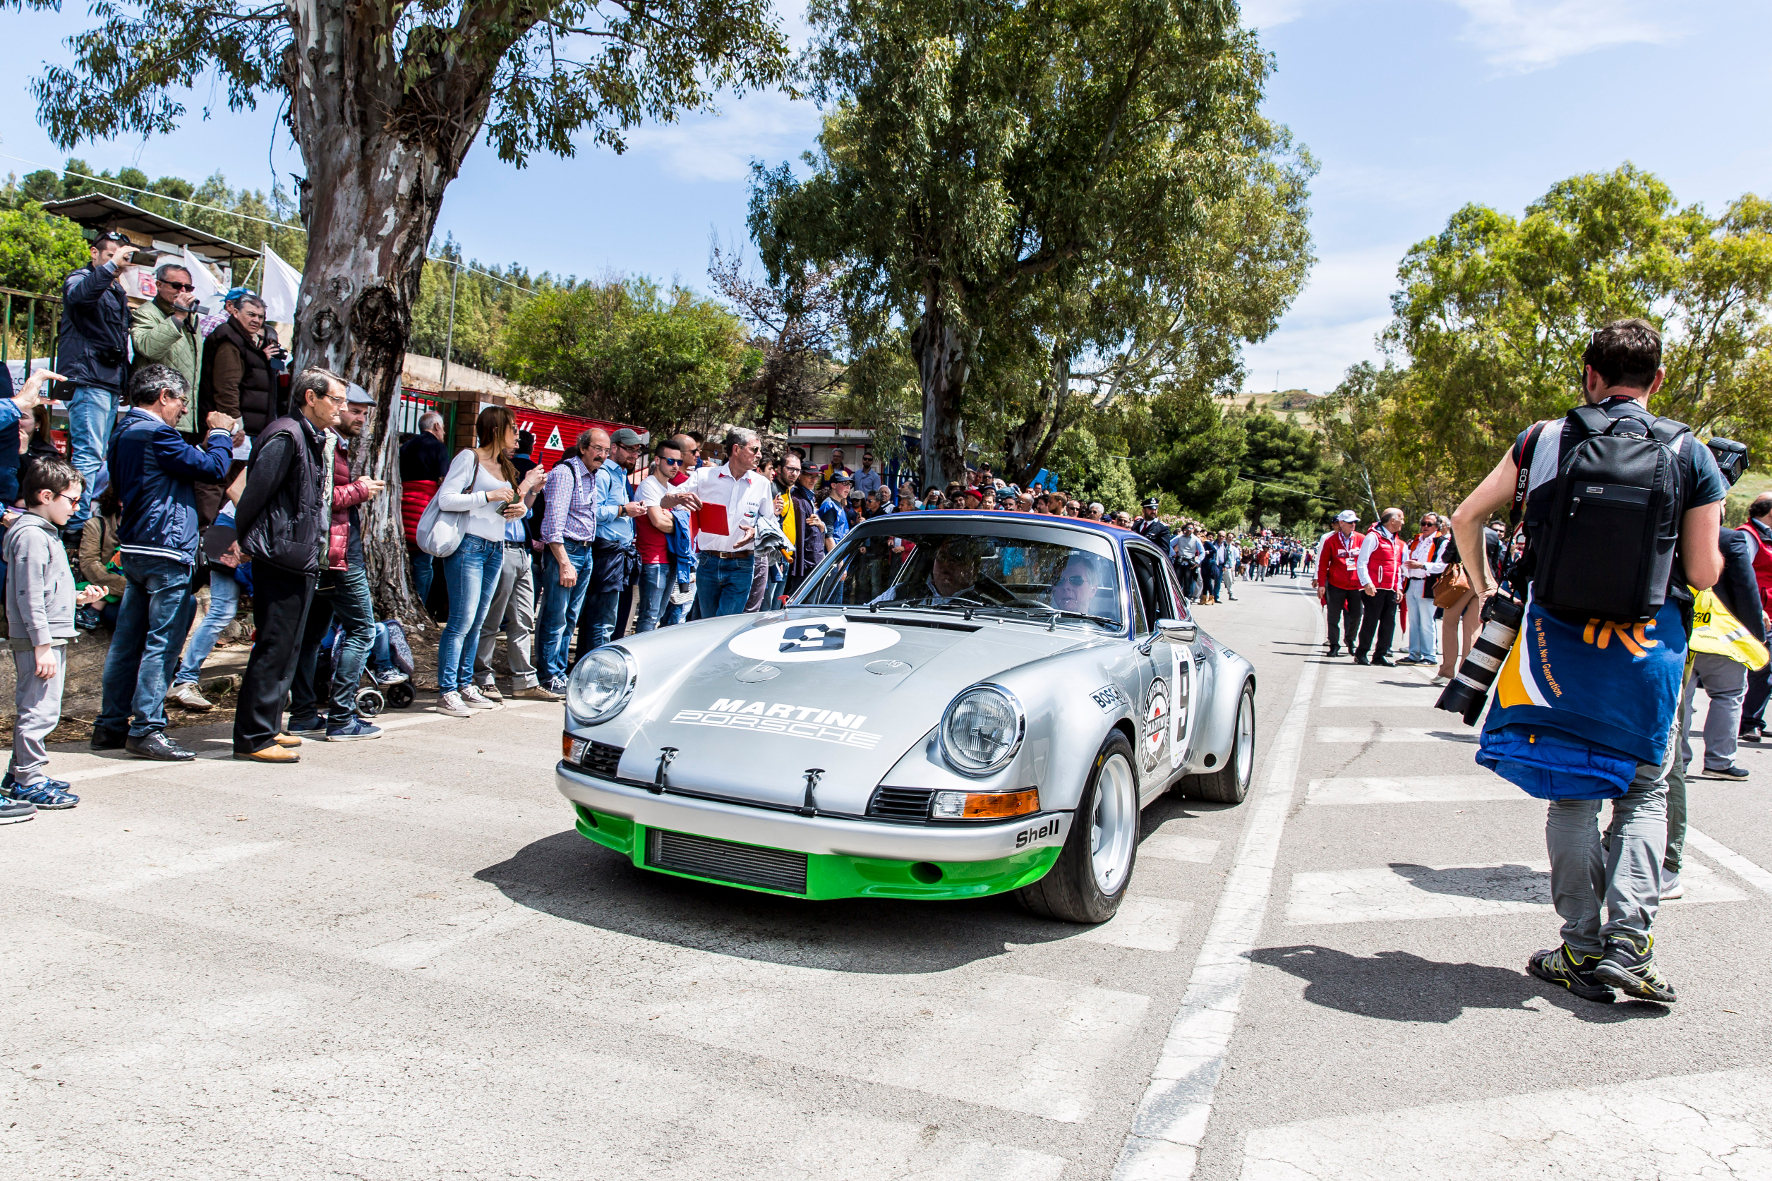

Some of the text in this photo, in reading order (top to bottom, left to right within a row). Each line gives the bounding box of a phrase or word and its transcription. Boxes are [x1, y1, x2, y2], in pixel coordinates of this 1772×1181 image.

[1516, 468, 1528, 502] EOS 7D
[778, 624, 847, 652] 9
[708, 698, 868, 730] MARTINI
[1176, 660, 1190, 742] 9
[669, 709, 883, 749] PORSCHE
[1016, 818, 1060, 848] Shell
